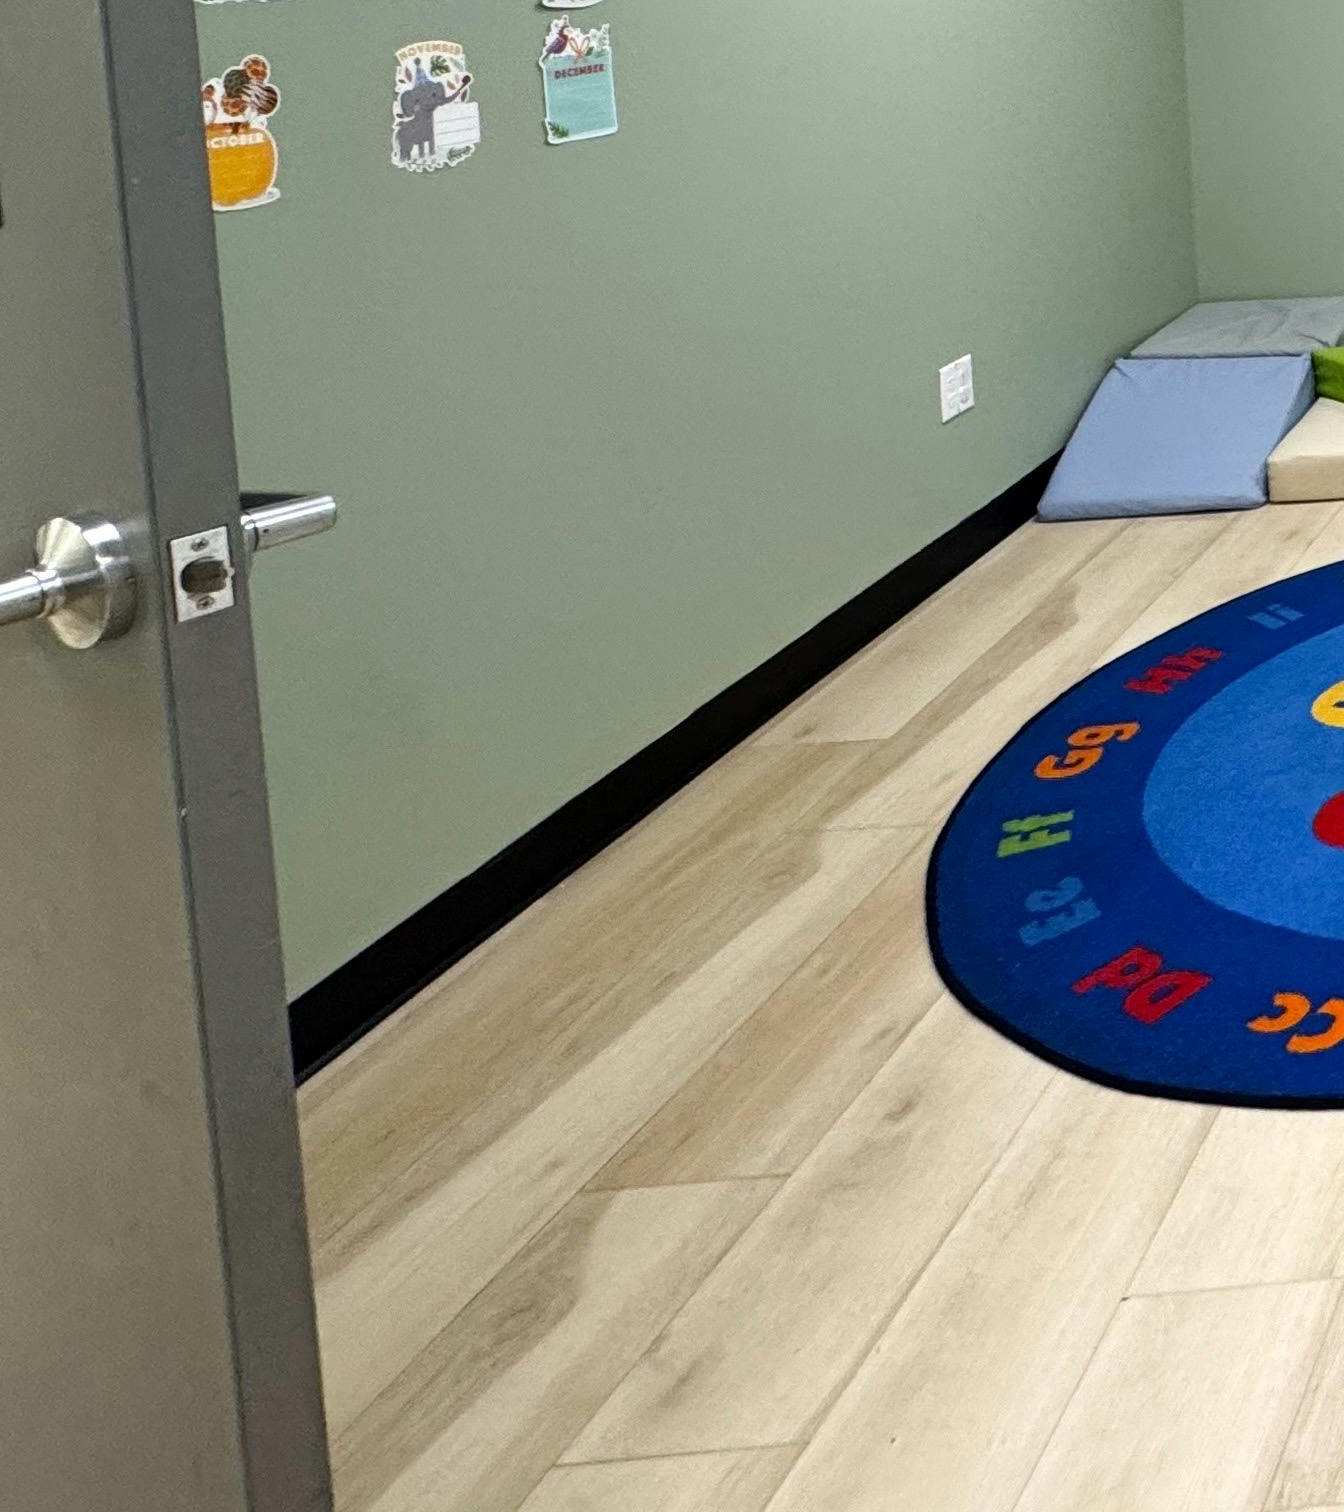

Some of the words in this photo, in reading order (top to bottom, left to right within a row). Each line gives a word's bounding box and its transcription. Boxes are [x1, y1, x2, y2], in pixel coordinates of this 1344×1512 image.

[399, 43, 462, 61] NOVEMBER
[554, 63, 605, 79] DECEMBER
[1034, 721, 1141, 779] Gg
[1072, 945, 1213, 1024] Dd
